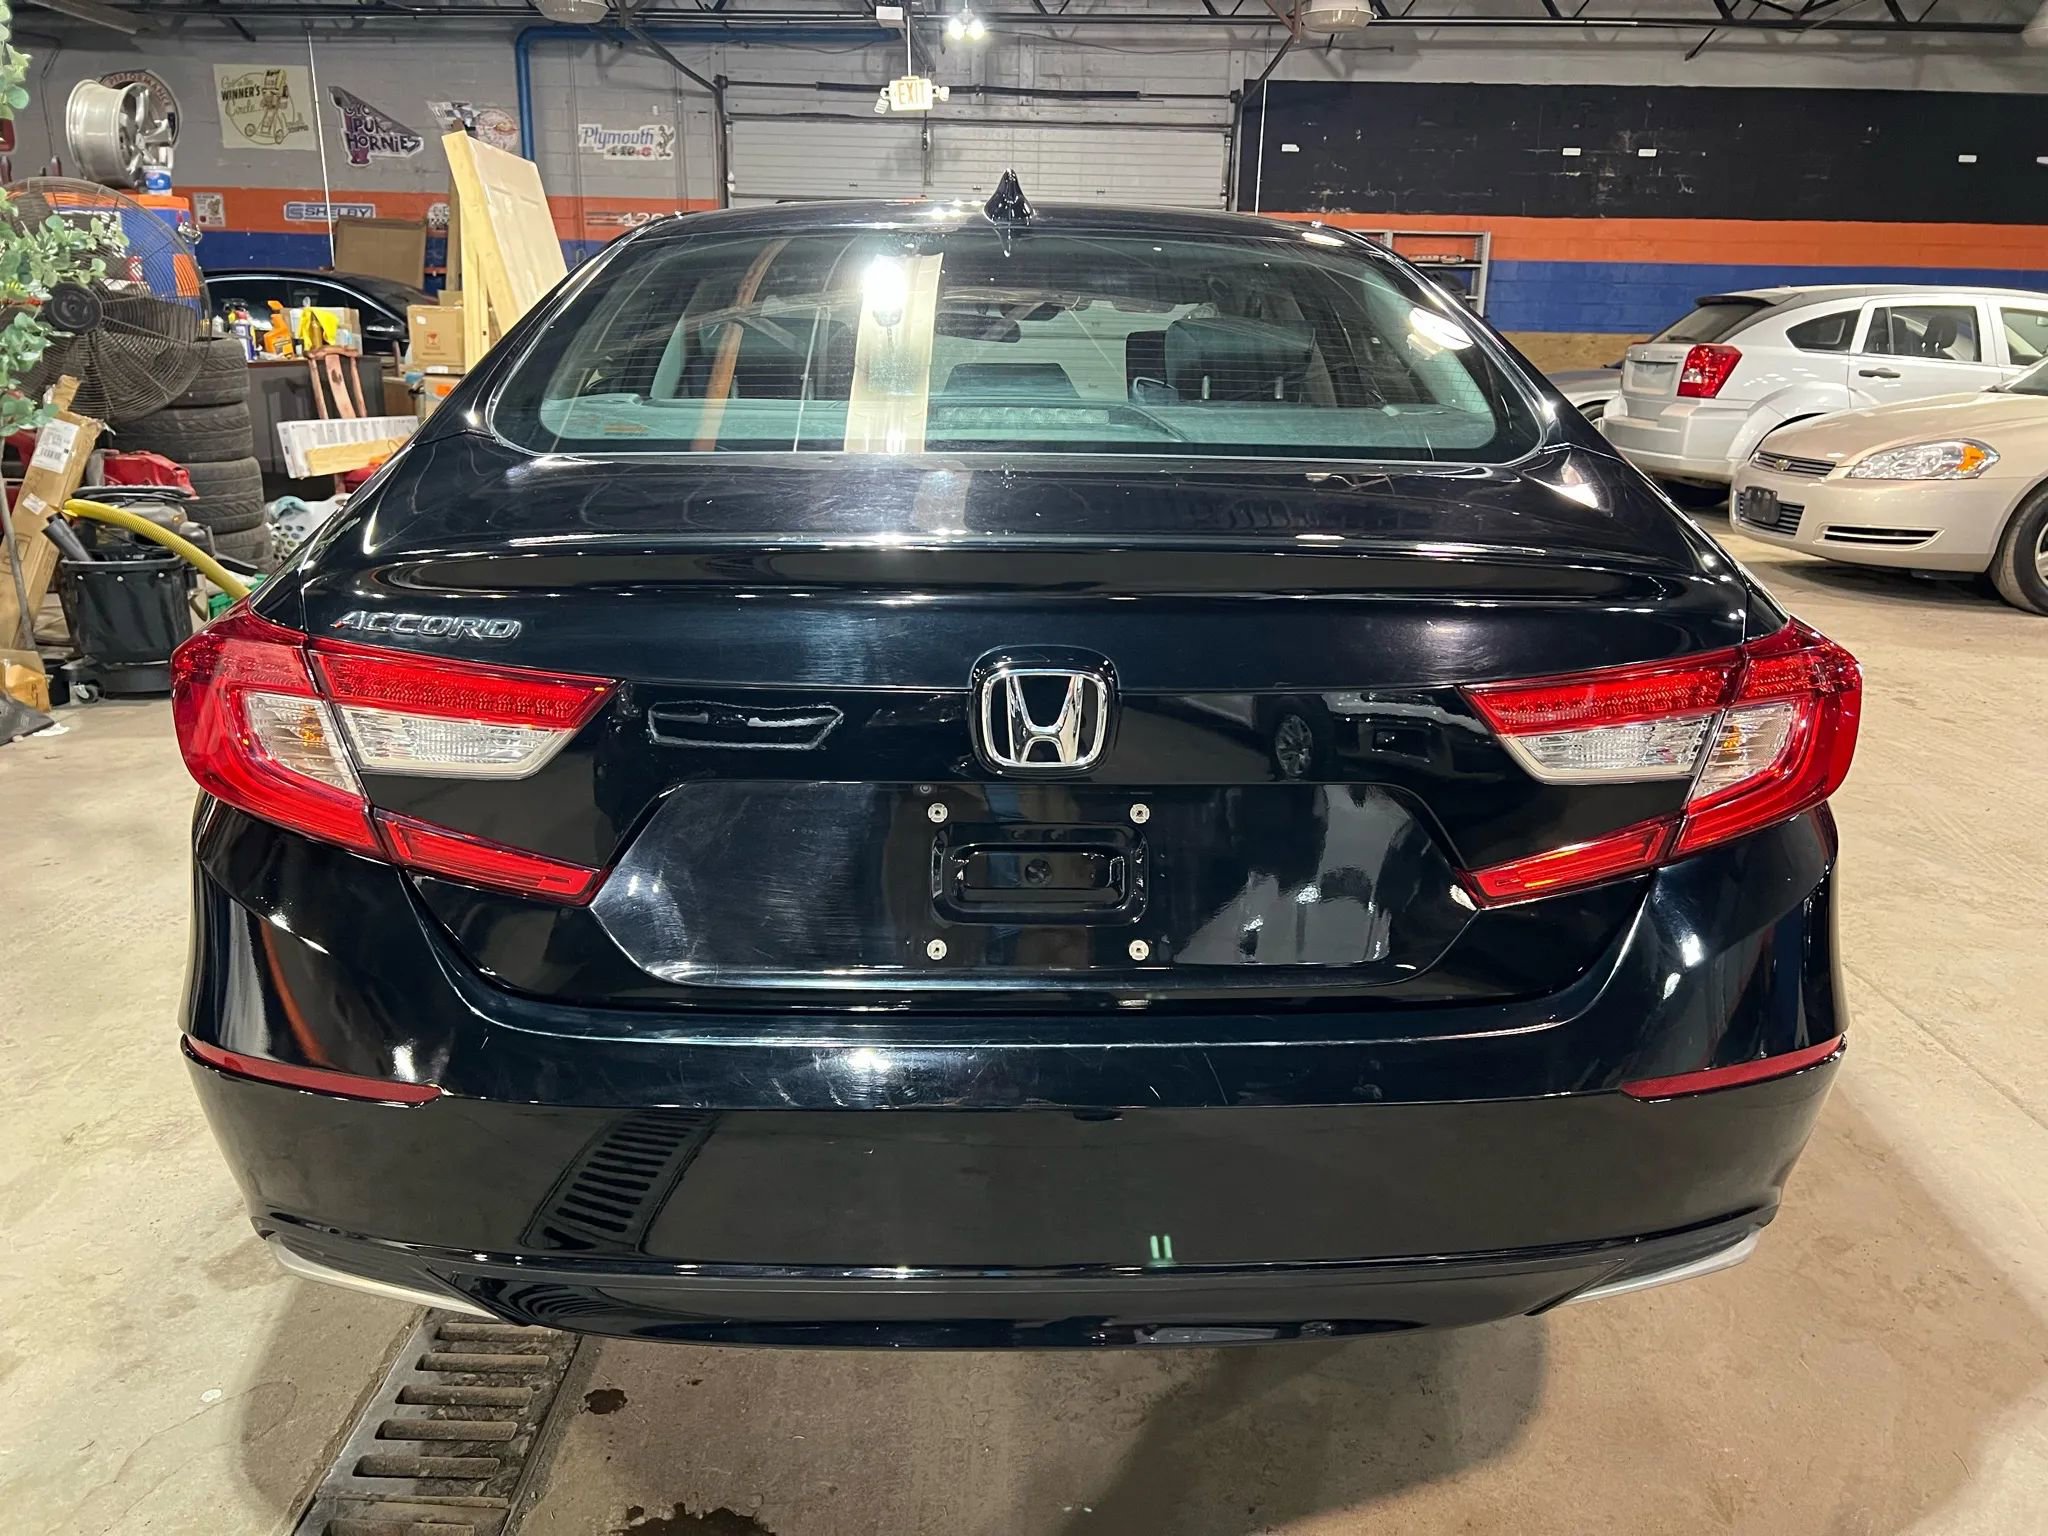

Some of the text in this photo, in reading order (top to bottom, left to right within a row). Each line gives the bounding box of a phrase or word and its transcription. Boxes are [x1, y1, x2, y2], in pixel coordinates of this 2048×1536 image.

[221, 85, 260, 101] WINNER'S
[898, 82, 926, 104] EXIT
[581, 126, 654, 150] Plymouth
[305, 205, 370, 218] SHELBY
[330, 610, 522, 640] ACCORD
